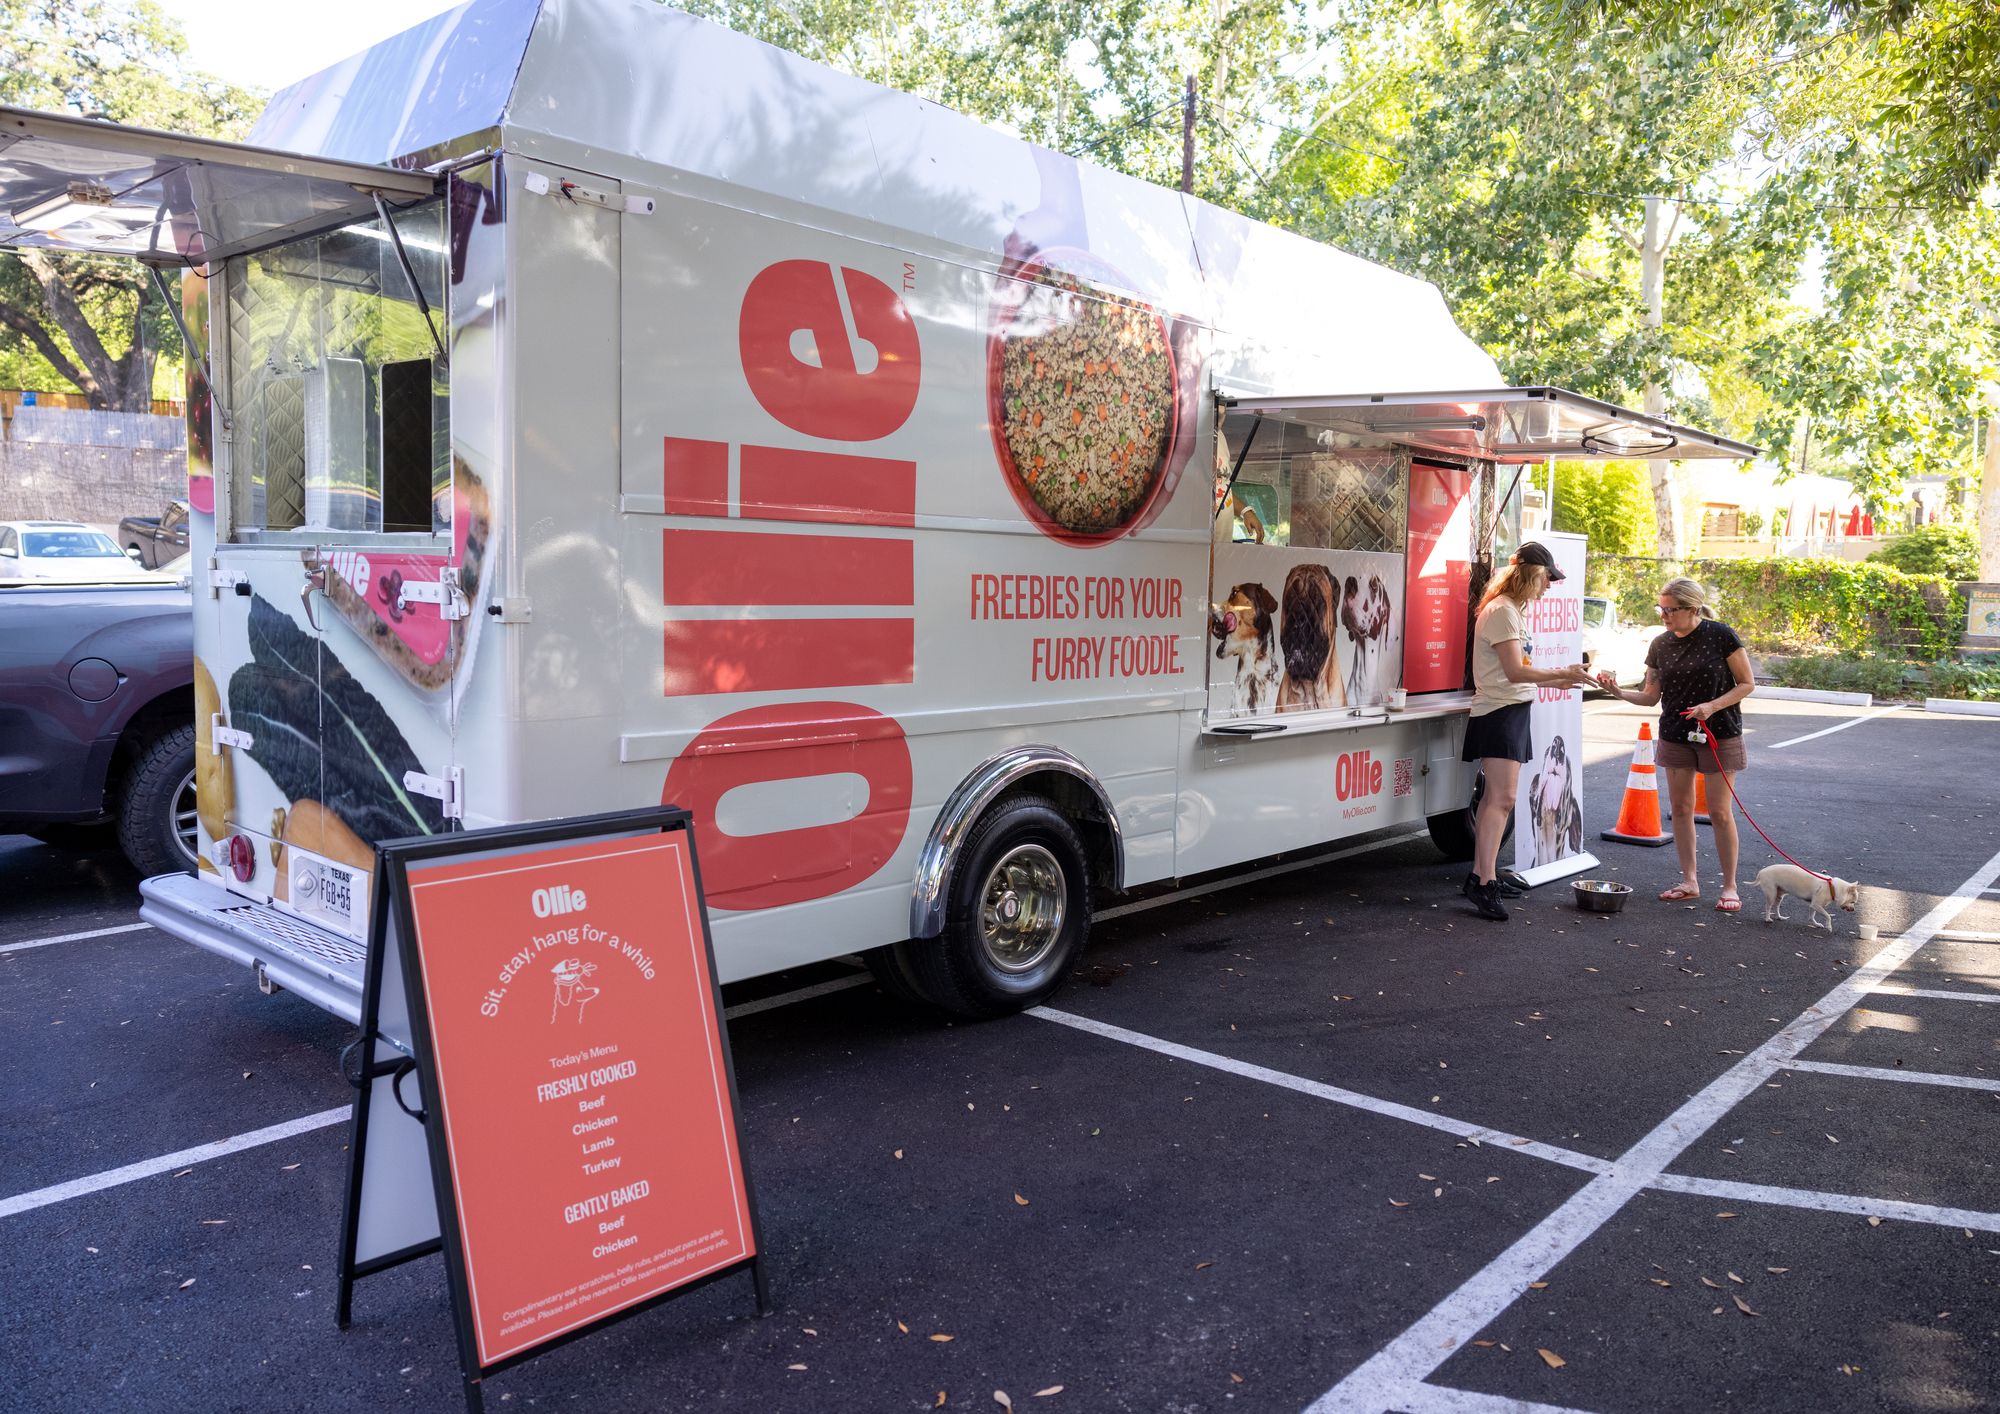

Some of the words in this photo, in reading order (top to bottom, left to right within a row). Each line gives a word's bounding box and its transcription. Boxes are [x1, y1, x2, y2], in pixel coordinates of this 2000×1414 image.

[661, 258, 921, 911] Ollie
[970, 574, 1080, 620] FREEBIES
[1084, 576, 1125, 619] FOR
[1129, 577, 1183, 619] YOUR
[1526, 597, 1579, 633] FREEBIES
[1031, 636, 1106, 682] FURRY
[1109, 635, 1185, 678] FOODIE.
[1335, 750, 1383, 801] Ollie
[1342, 805, 1377, 820] MyOllie.com
[331, 868, 351, 883] TEXAS
[531, 884, 587, 918] Ollie
[480, 988, 507, 1017] Sit,
[499, 947, 536, 984] stay,
[532, 927, 579, 951] hang
[582, 923, 608, 942] for
[608, 935, 620, 948] a
[621, 942, 655, 980] while
[549, 1051, 590, 1069] Today's
[590, 1044, 618, 1059] Menu
[537, 1073, 588, 1103] FRESHLY
[590, 1060, 638, 1087] COOKED
[579, 1095, 606, 1112] Beef
[572, 1115, 618, 1136] Chicken
[582, 1136, 615, 1154] Lamb
[582, 1157, 621, 1175] Turkey
[564, 1193, 609, 1224] GENTLY
[610, 1179, 650, 1207] BAKED
[598, 1216, 625, 1234] Beef
[592, 1235, 638, 1258] Chicken
[502, 1291, 563, 1321] Complimentary
[564, 1287, 577, 1297] ear
[617, 1262, 635, 1277] belly
[653, 1250, 667, 1262] and
[698, 1235, 710, 1244] are
[710, 1229, 724, 1240] also
[537, 1306, 564, 1321] Please
[564, 1299, 578, 1310] ask
[578, 1294, 592, 1304] the
[592, 1282, 621, 1299] nearest
[620, 1274, 638, 1287] Ollie
[638, 1267, 657, 1280] team
[656, 1256, 686, 1273] member
[686, 1250, 697, 1261] for
[697, 1244, 715, 1256] more
